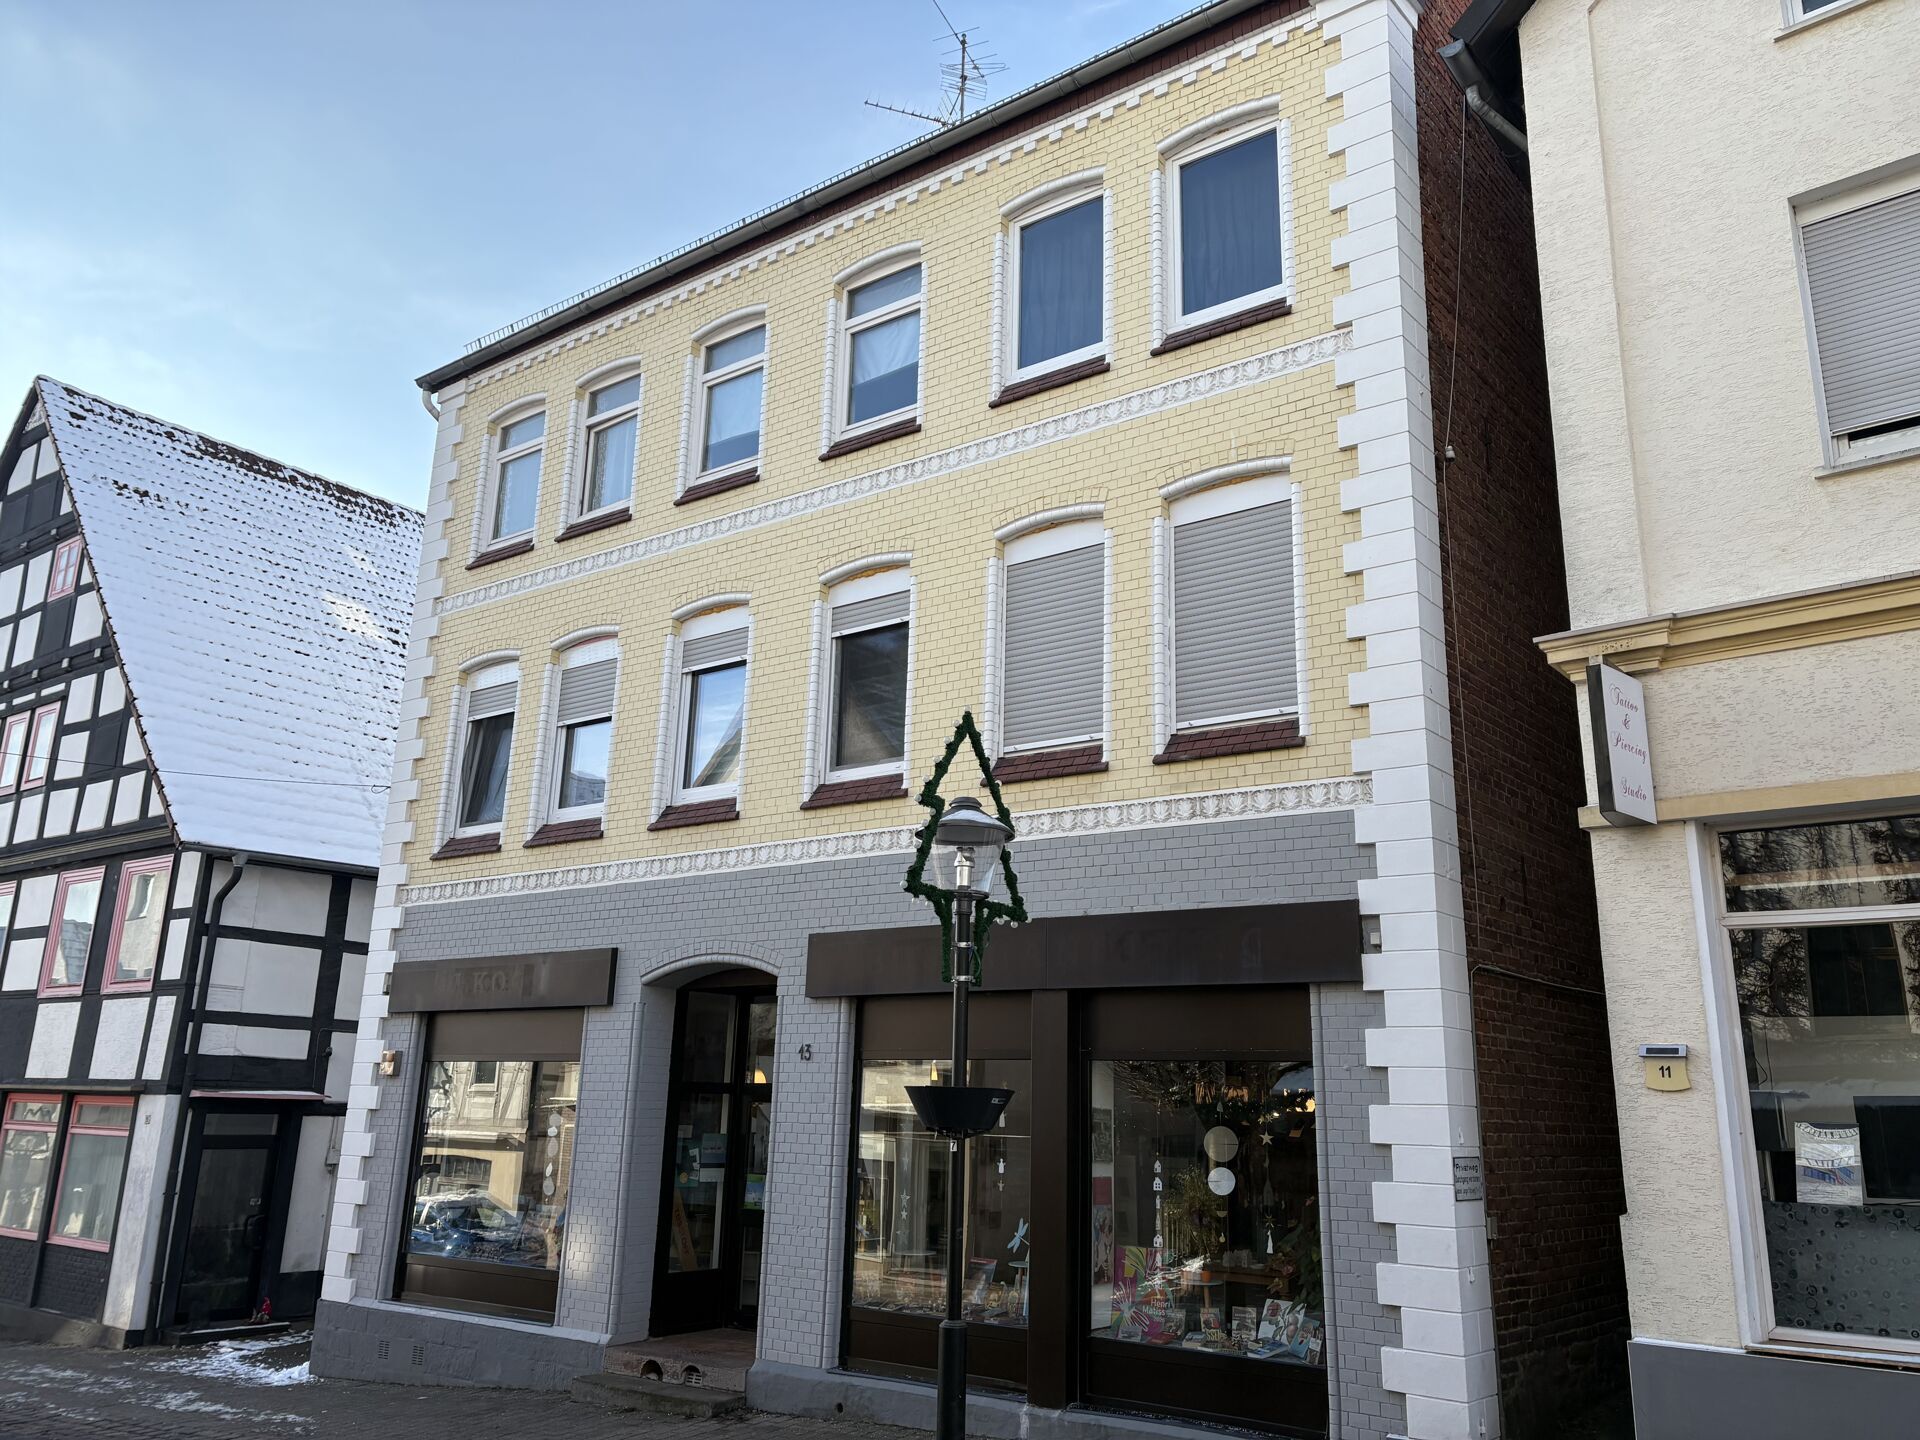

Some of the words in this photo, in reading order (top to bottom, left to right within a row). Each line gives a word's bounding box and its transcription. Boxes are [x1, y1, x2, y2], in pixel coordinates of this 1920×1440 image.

[1609, 683, 1638, 712] Tattoo
[1621, 713, 1631, 730] &
[1612, 732, 1647, 765] Piercing
[1621, 777, 1647, 801] Studio
[798, 1043, 812, 1061] 13
[1659, 1065, 1672, 1079] 11
[1142, 1305, 1167, 1316] Matiss
[1150, 1298, 1171, 1309] Henri
